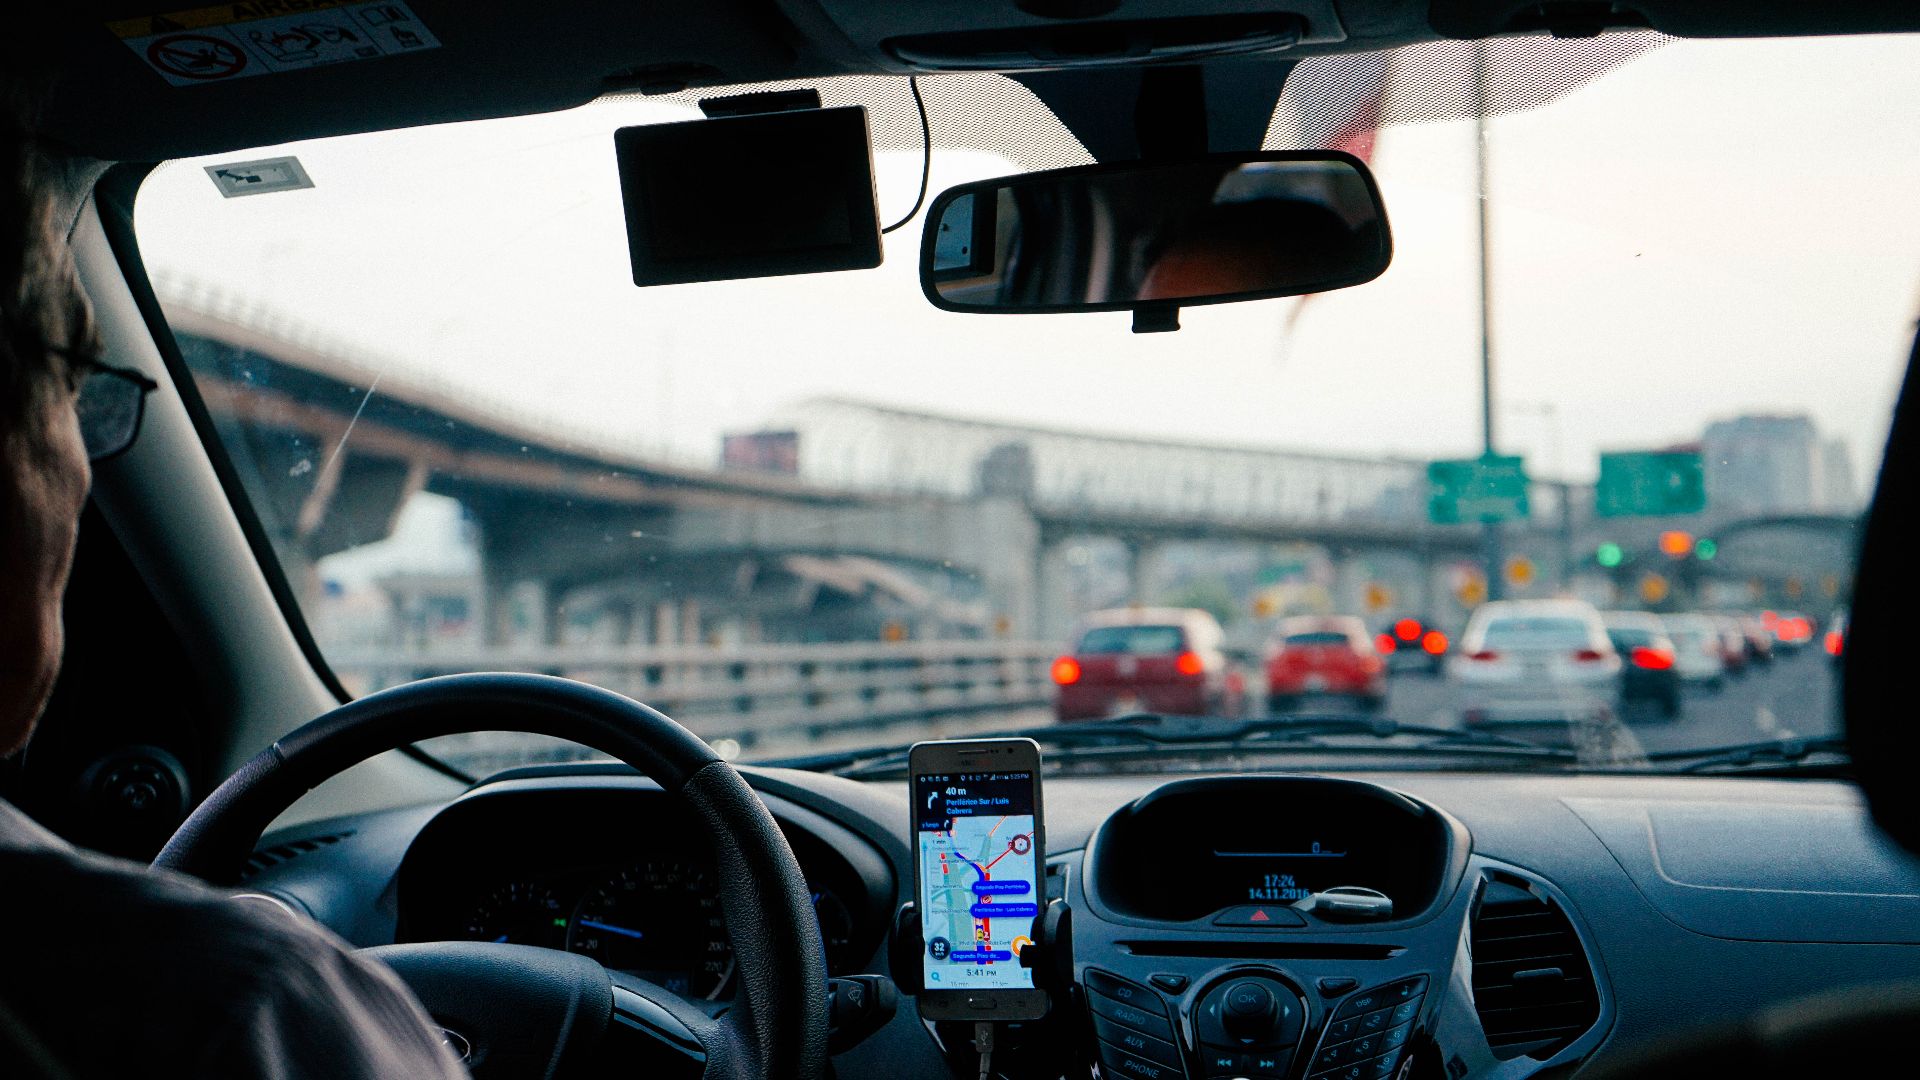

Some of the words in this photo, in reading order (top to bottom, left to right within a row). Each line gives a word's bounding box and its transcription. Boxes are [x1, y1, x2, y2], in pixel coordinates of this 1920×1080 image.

[946, 787, 956, 796] 40
[1264, 874, 1295, 888] 17:24
[1249, 888, 1310, 900] 14.11.2016
[707, 940, 725, 952] 200
[934, 942, 945, 952] 32
[704, 960, 723, 972] 220
[1117, 988, 1132, 998] CD
[1238, 994, 1257, 1004] OK
[1403, 1005, 1411, 1013] 3
[1114, 1009, 1145, 1025] RADIO
[1372, 1015, 1380, 1023] 2
[1343, 1024, 1348, 1032] 1
[1124, 1035, 1145, 1049] AUX
[1362, 1041, 1370, 1049] 5
[1330, 1049, 1337, 1057] 4
[1382, 1056, 1390, 1066] 9
[1123, 1060, 1160, 1079] PHONE
[1351, 1067, 1359, 1077] 8
